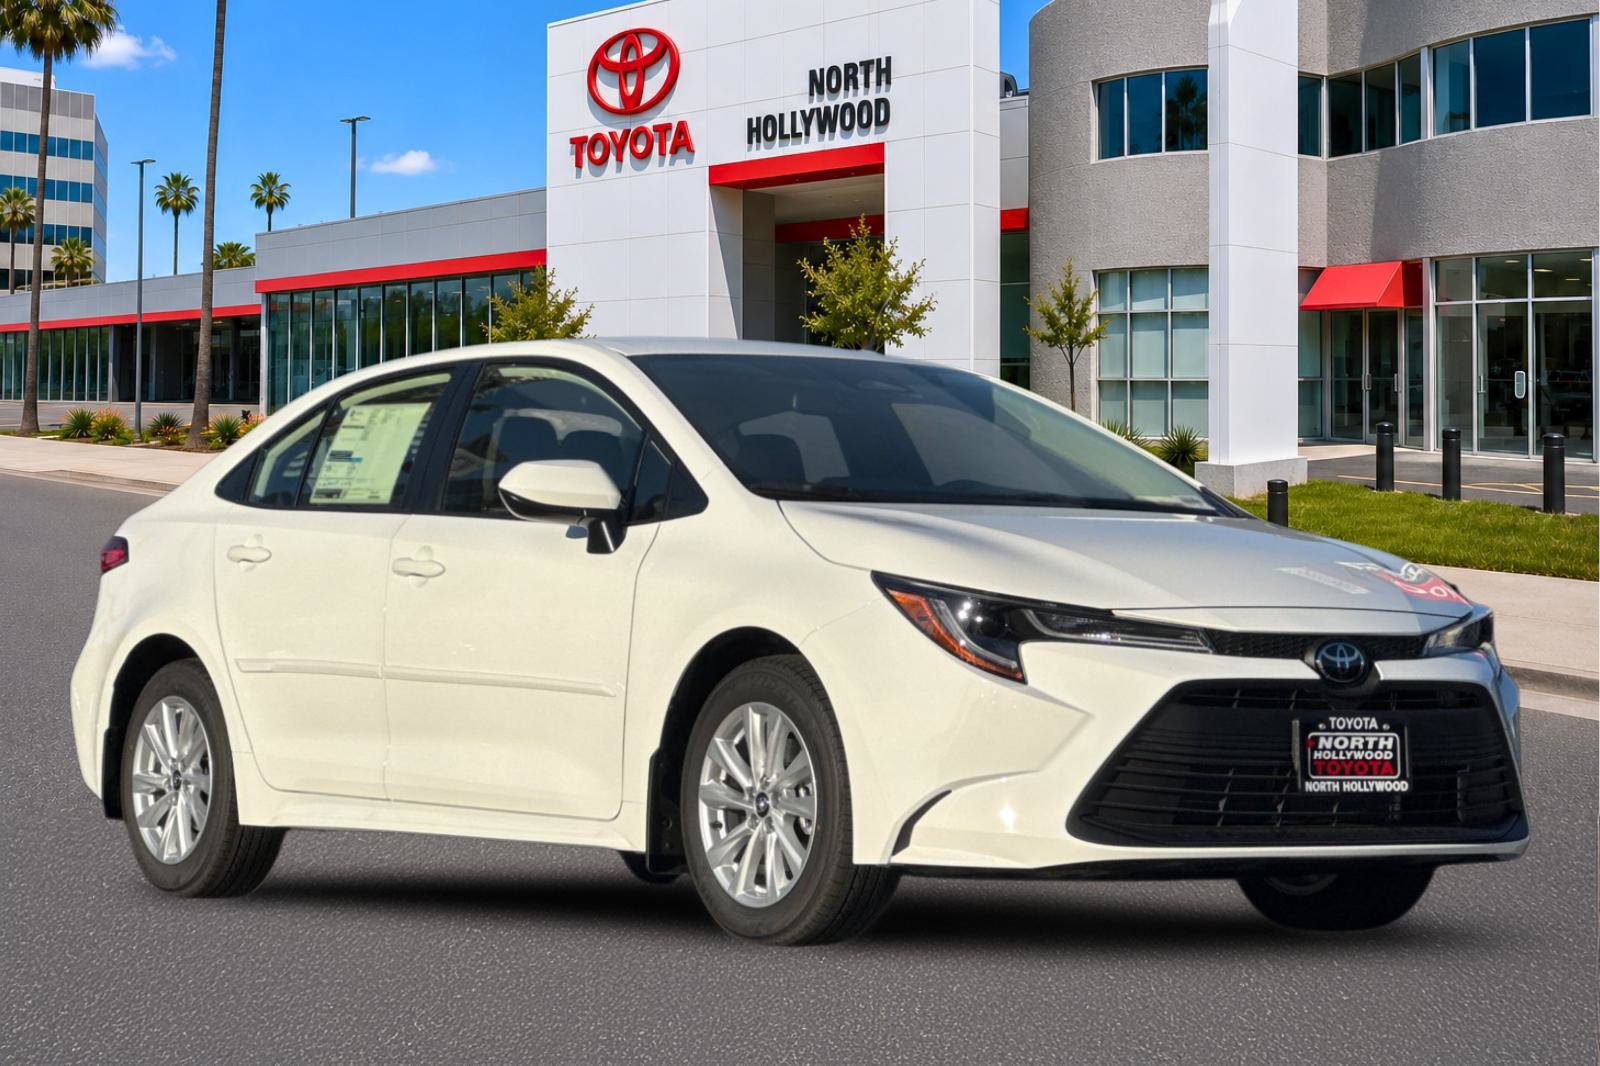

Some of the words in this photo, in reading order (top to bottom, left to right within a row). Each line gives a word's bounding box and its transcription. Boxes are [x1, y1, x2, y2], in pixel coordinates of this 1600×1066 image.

[808, 56, 892, 97] NORTH
[747, 97, 891, 145] HOLLYWOOD
[570, 120, 695, 169] TOYOTA
[1329, 717, 1378, 730] TOYOTA
[1318, 736, 1394, 750] NORTH
[1313, 750, 1394, 760] HOLLYWOOD
[1314, 760, 1394, 776] TOYOTA
[1305, 781, 1340, 792] NORTH
[1342, 781, 1409, 792] HOLLYWOOD
